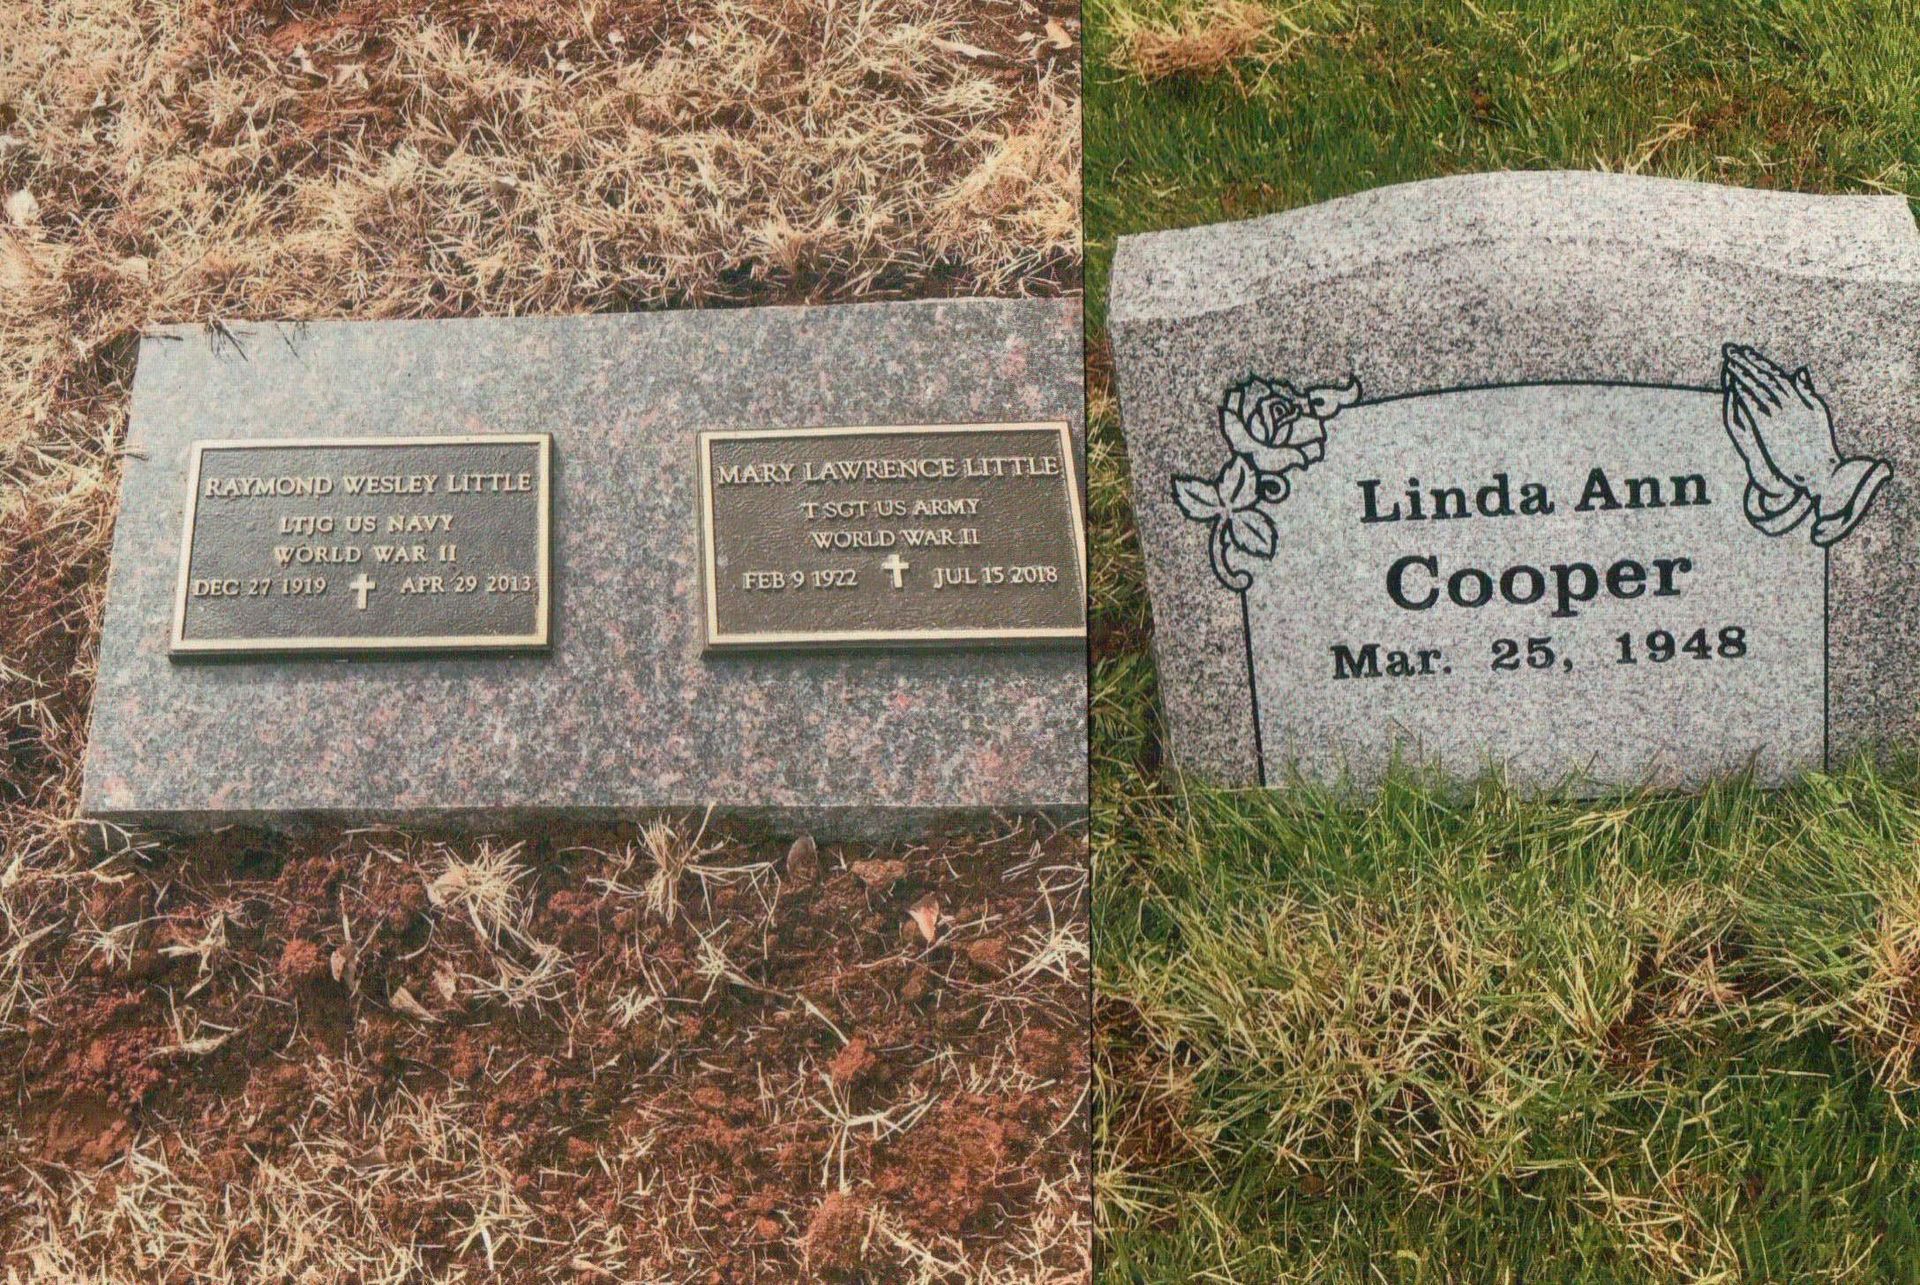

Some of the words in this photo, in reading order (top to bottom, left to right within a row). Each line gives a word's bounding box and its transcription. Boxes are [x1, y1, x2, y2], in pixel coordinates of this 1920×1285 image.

[718, 463, 796, 485] MARY
[804, 458, 956, 482] LAWRENCE
[964, 456, 1061, 478] LITTLE
[204, 476, 335, 498] RAYMOND
[343, 474, 438, 497] WESLEY
[448, 473, 533, 493] LITTLE
[1357, 473, 1555, 523] Linda
[1574, 467, 1712, 512] Ann
[801, 501, 821, 519] T
[823, 501, 869, 518] SGT
[876, 500, 907, 517] US
[913, 499, 981, 516] ARMY
[279, 517, 335, 535] LTJG
[345, 516, 378, 534] US
[387, 515, 455, 533] NAVY
[811, 530, 896, 550] WORLD
[900, 529, 957, 547] WAR
[960, 528, 981, 545] II
[274, 545, 364, 565] WORLD
[373, 544, 429, 563] WAR
[438, 544, 458, 562] II
[192, 579, 241, 597] DEC
[248, 579, 273, 596] 27
[281, 579, 328, 596] 1919
[400, 576, 446, 595] APR
[453, 576, 478, 593] 29
[486, 575, 533, 592] 2013
[741, 571, 787, 590] FEB
[790, 570, 805, 589] 9
[812, 569, 858, 588] 1922
[932, 567, 978, 590] JUL
[982, 567, 1005, 585] 15
[1010, 566, 1058, 584] 2018
[1385, 554, 1693, 618] Cooper
[1330, 642, 1453, 679] Mar.
[1490, 636, 1573, 673] 25,
[1615, 626, 1747, 665] 1948
